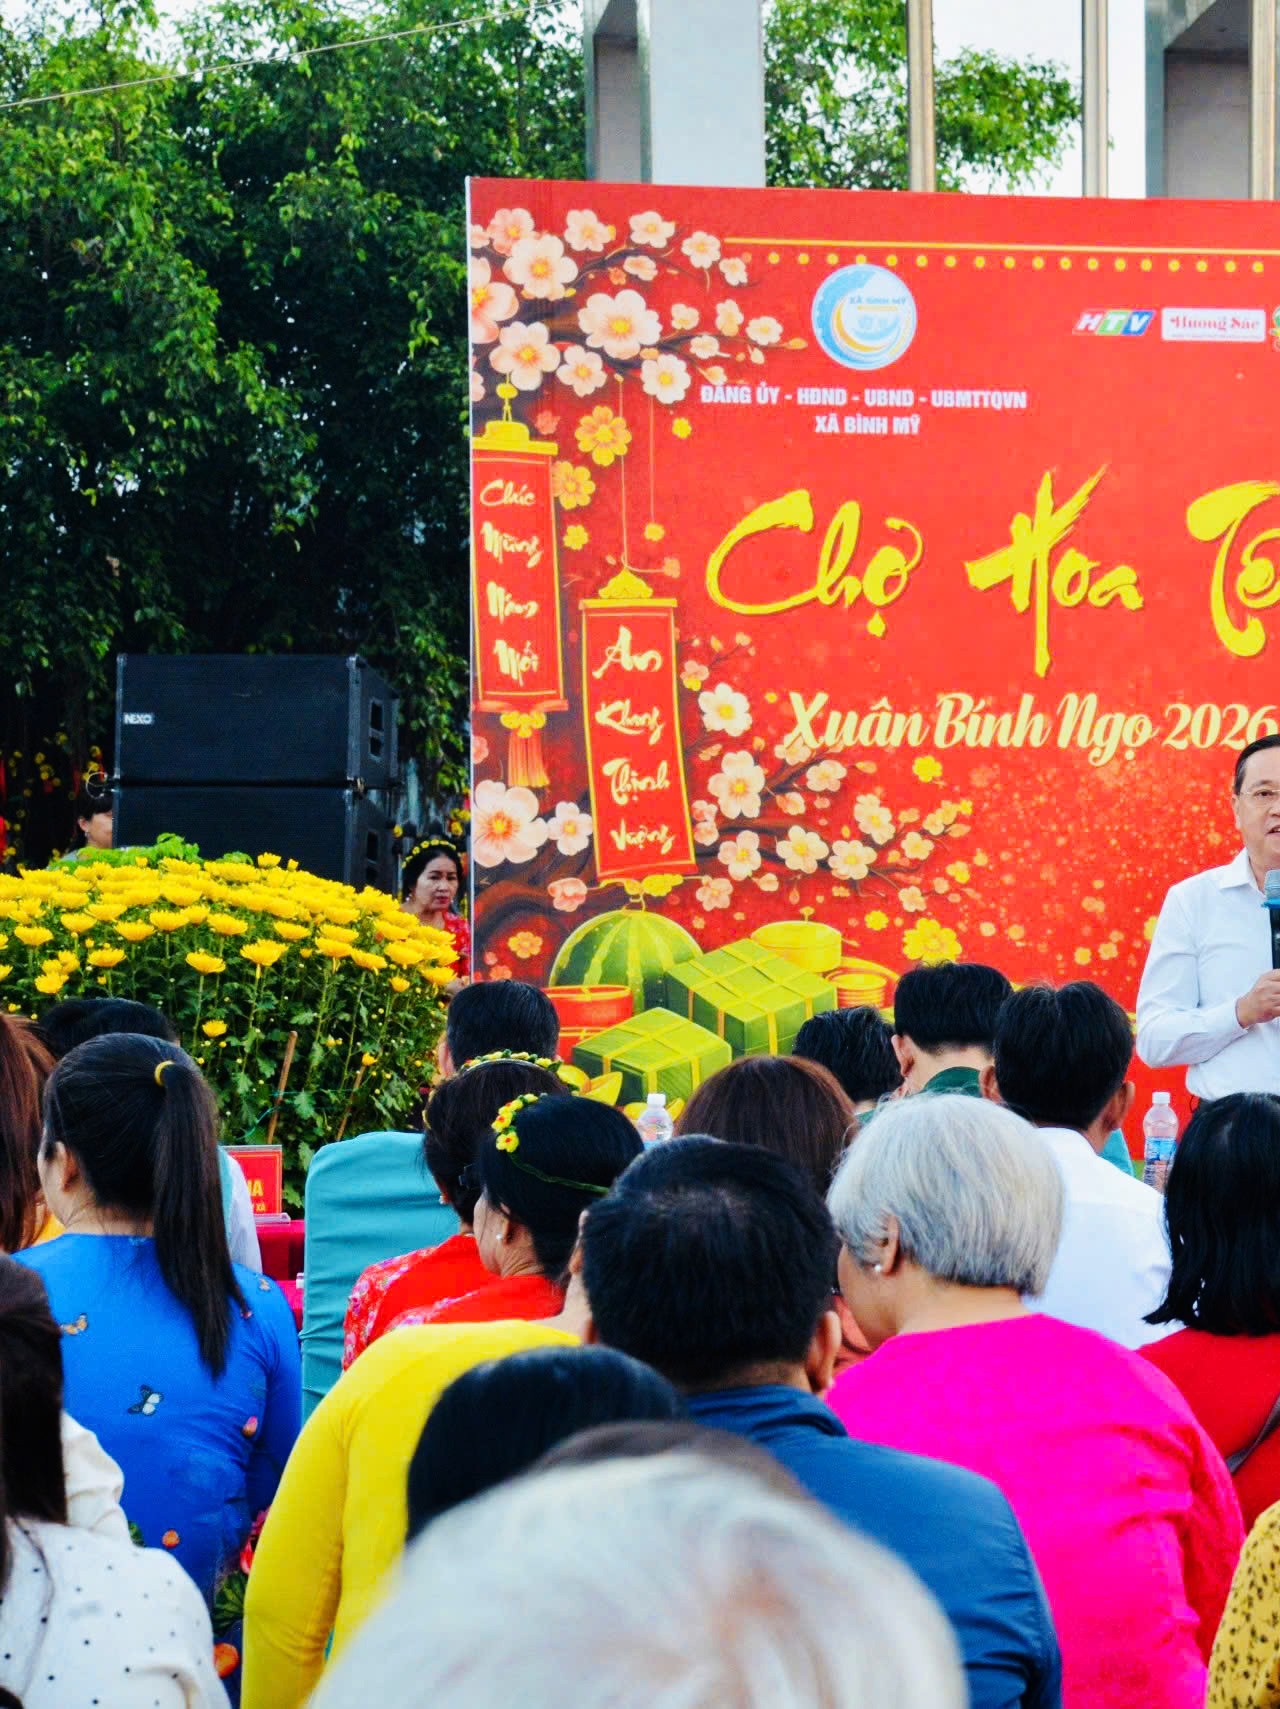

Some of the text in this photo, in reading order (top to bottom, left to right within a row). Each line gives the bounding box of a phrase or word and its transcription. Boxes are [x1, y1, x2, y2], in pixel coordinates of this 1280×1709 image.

[1075, 312, 1151, 332] HTV
[797, 387, 847, 407] HĐND
[864, 389, 915, 407] UBND
[931, 390, 1027, 409] UBMTTQVN
[814, 413, 921, 435] XÃ BÌNH MỸ
[479, 478, 536, 507] Chúc
[706, 488, 924, 638] Chợ
[963, 462, 1145, 678] Hoa
[493, 639, 539, 687] Mới
[592, 624, 664, 679] An
[123, 713, 153, 725] NEXO
[594, 698, 667, 745] Khang
[783, 691, 1279, 767] Xuân Bính Ngọ 2026
[602, 757, 671, 806] Thịnh
[610, 818, 676, 856] Vượng
